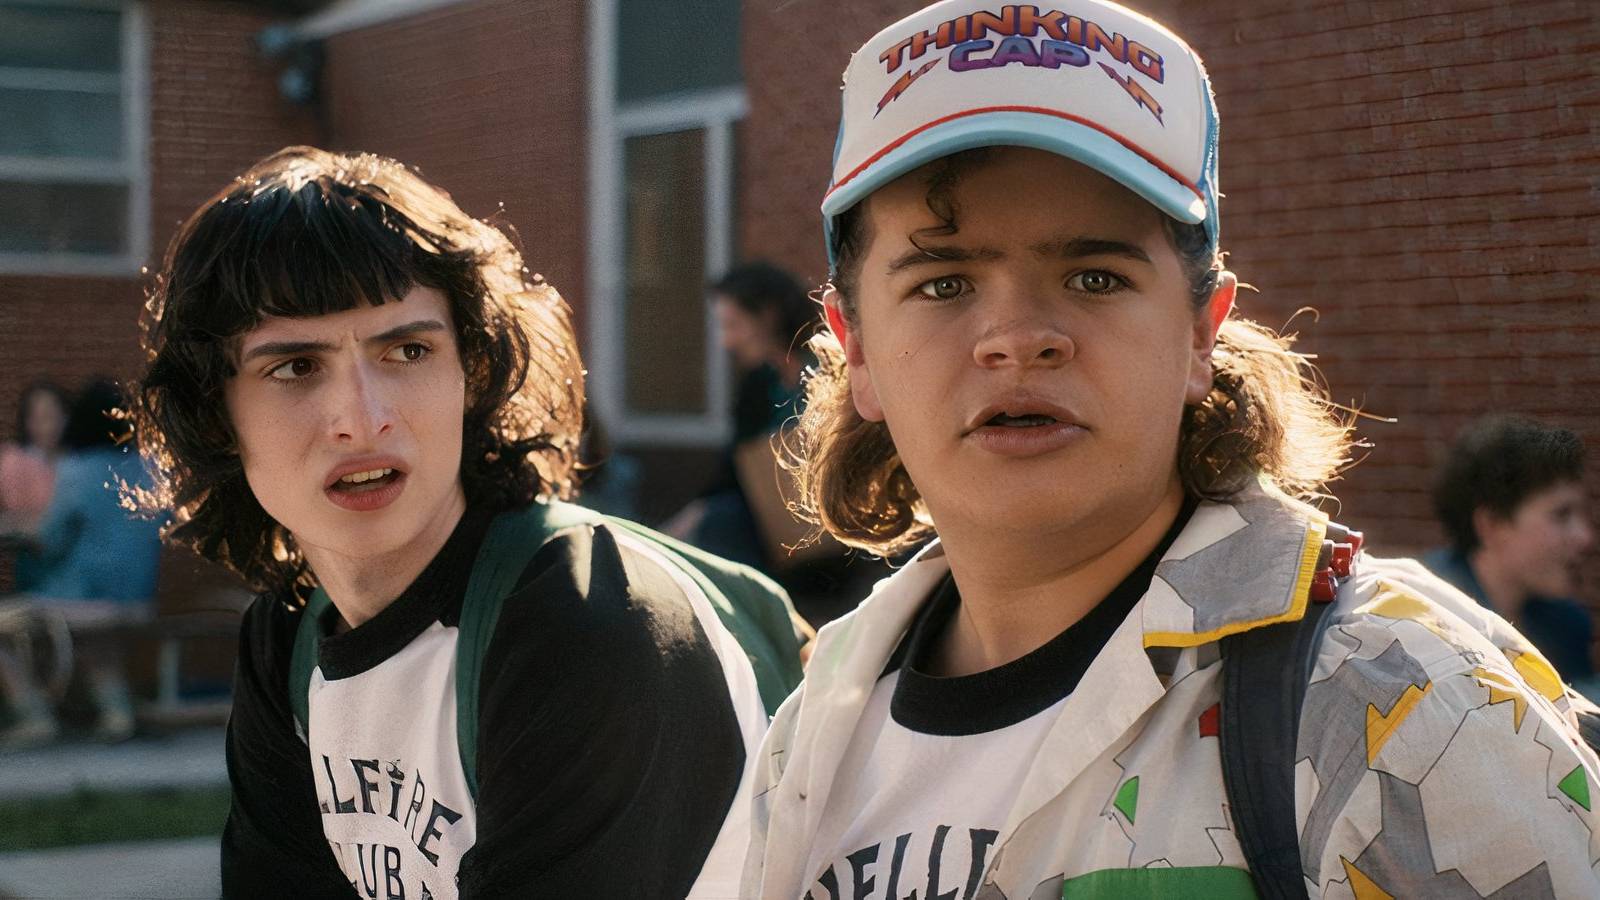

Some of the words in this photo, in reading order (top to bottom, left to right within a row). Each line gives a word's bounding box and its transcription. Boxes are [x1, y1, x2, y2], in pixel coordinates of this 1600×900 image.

[879, 5, 1164, 84] THINKING
[948, 37, 1090, 72] CAP
[321, 755, 463, 867] LFIRE
[352, 843, 405, 900] UB
